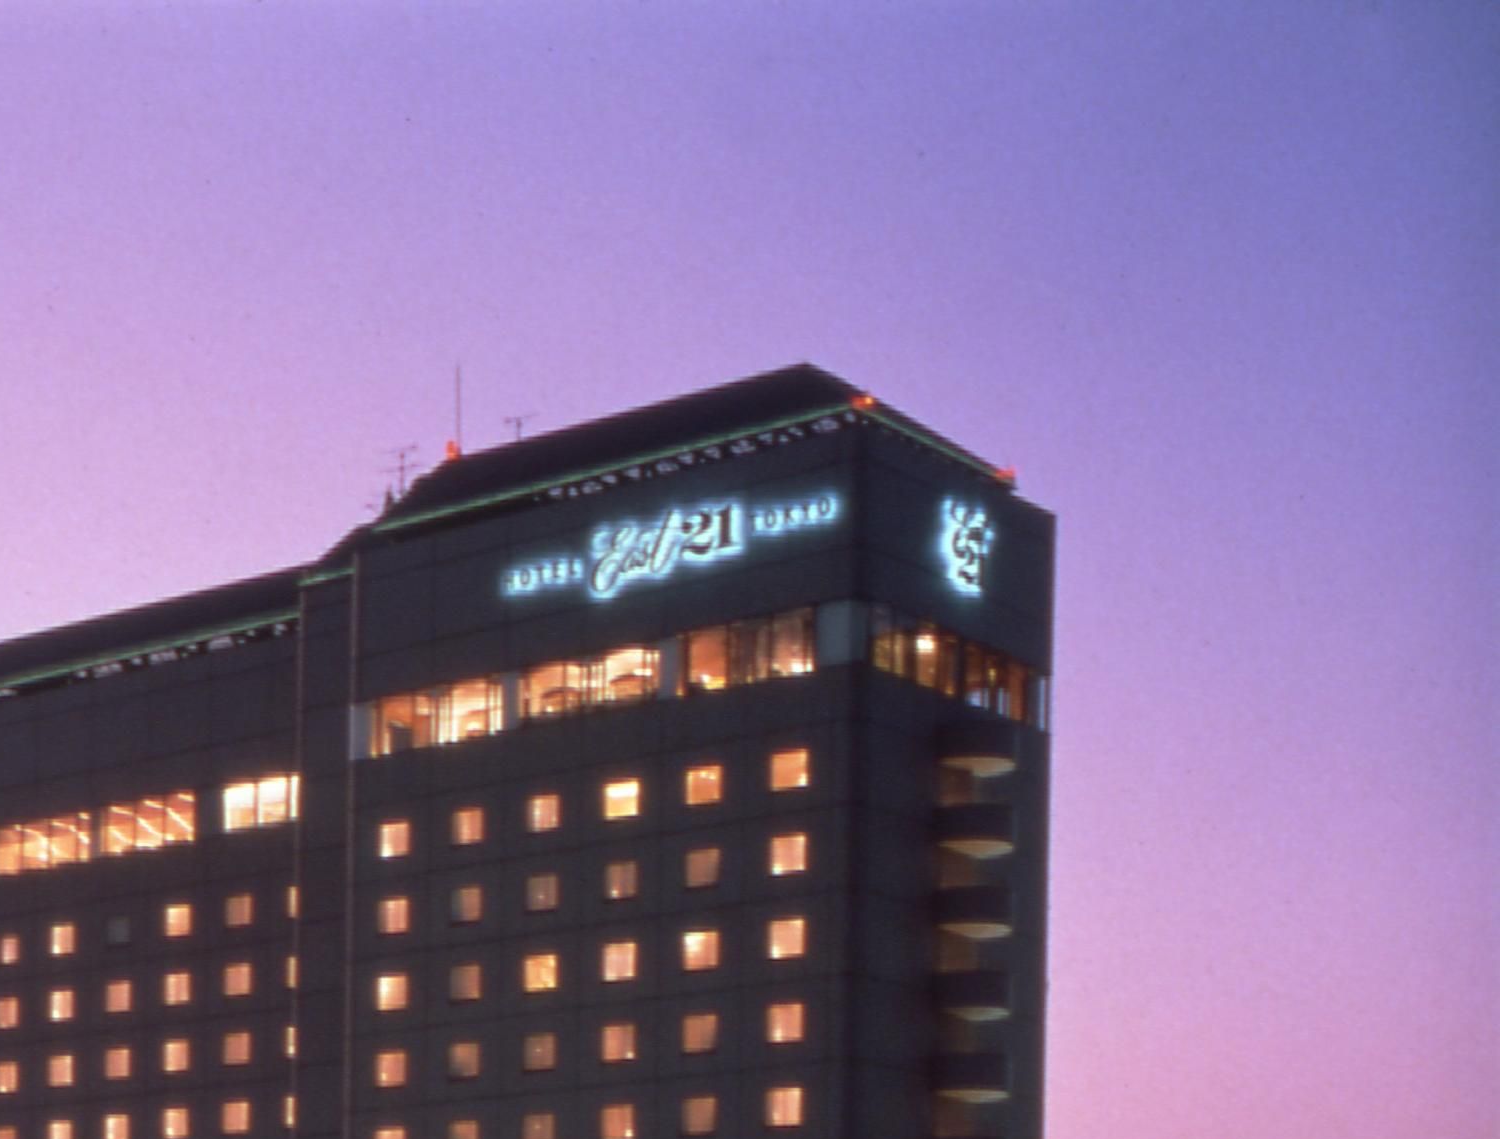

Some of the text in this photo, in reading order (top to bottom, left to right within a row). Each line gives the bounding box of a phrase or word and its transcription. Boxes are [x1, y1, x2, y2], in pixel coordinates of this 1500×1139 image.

[503, 495, 834, 596] HOTEL East 21 TOKYO
